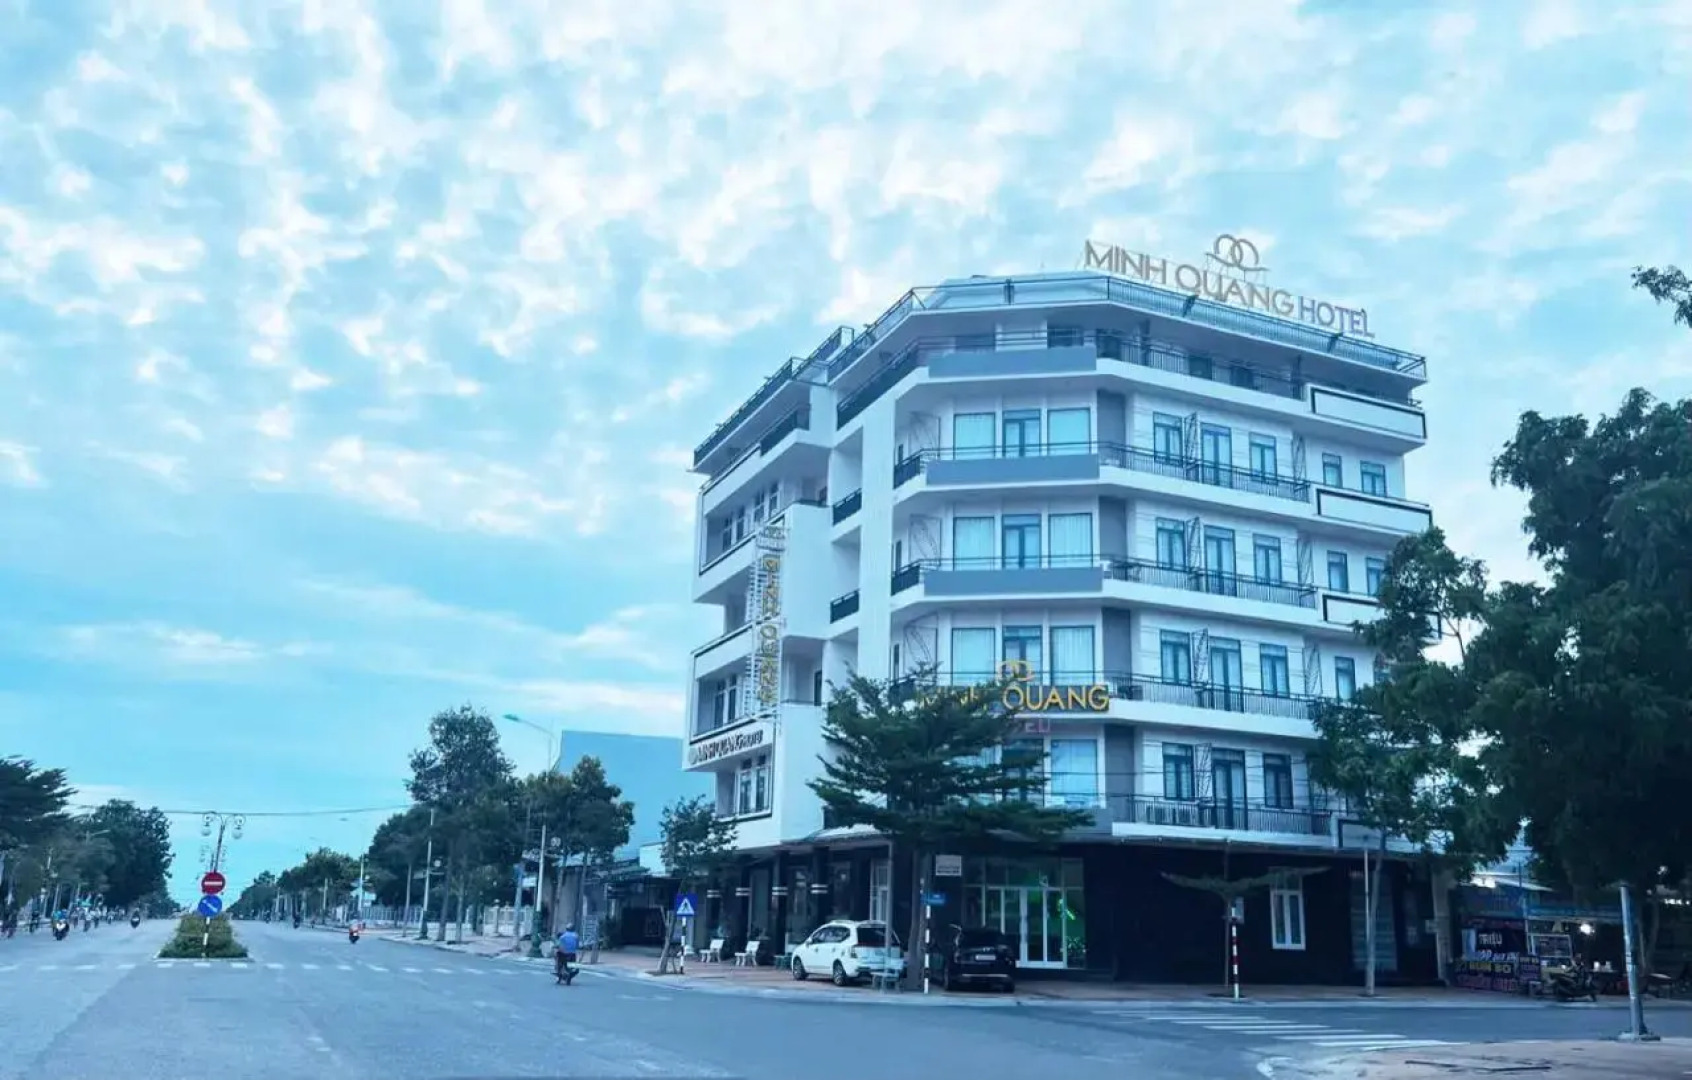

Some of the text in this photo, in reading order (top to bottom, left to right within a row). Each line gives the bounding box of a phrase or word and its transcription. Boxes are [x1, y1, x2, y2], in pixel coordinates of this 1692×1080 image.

[1084, 239, 1375, 338] MINH QUANG HOTEL
[1003, 684, 1109, 711] QUANG
